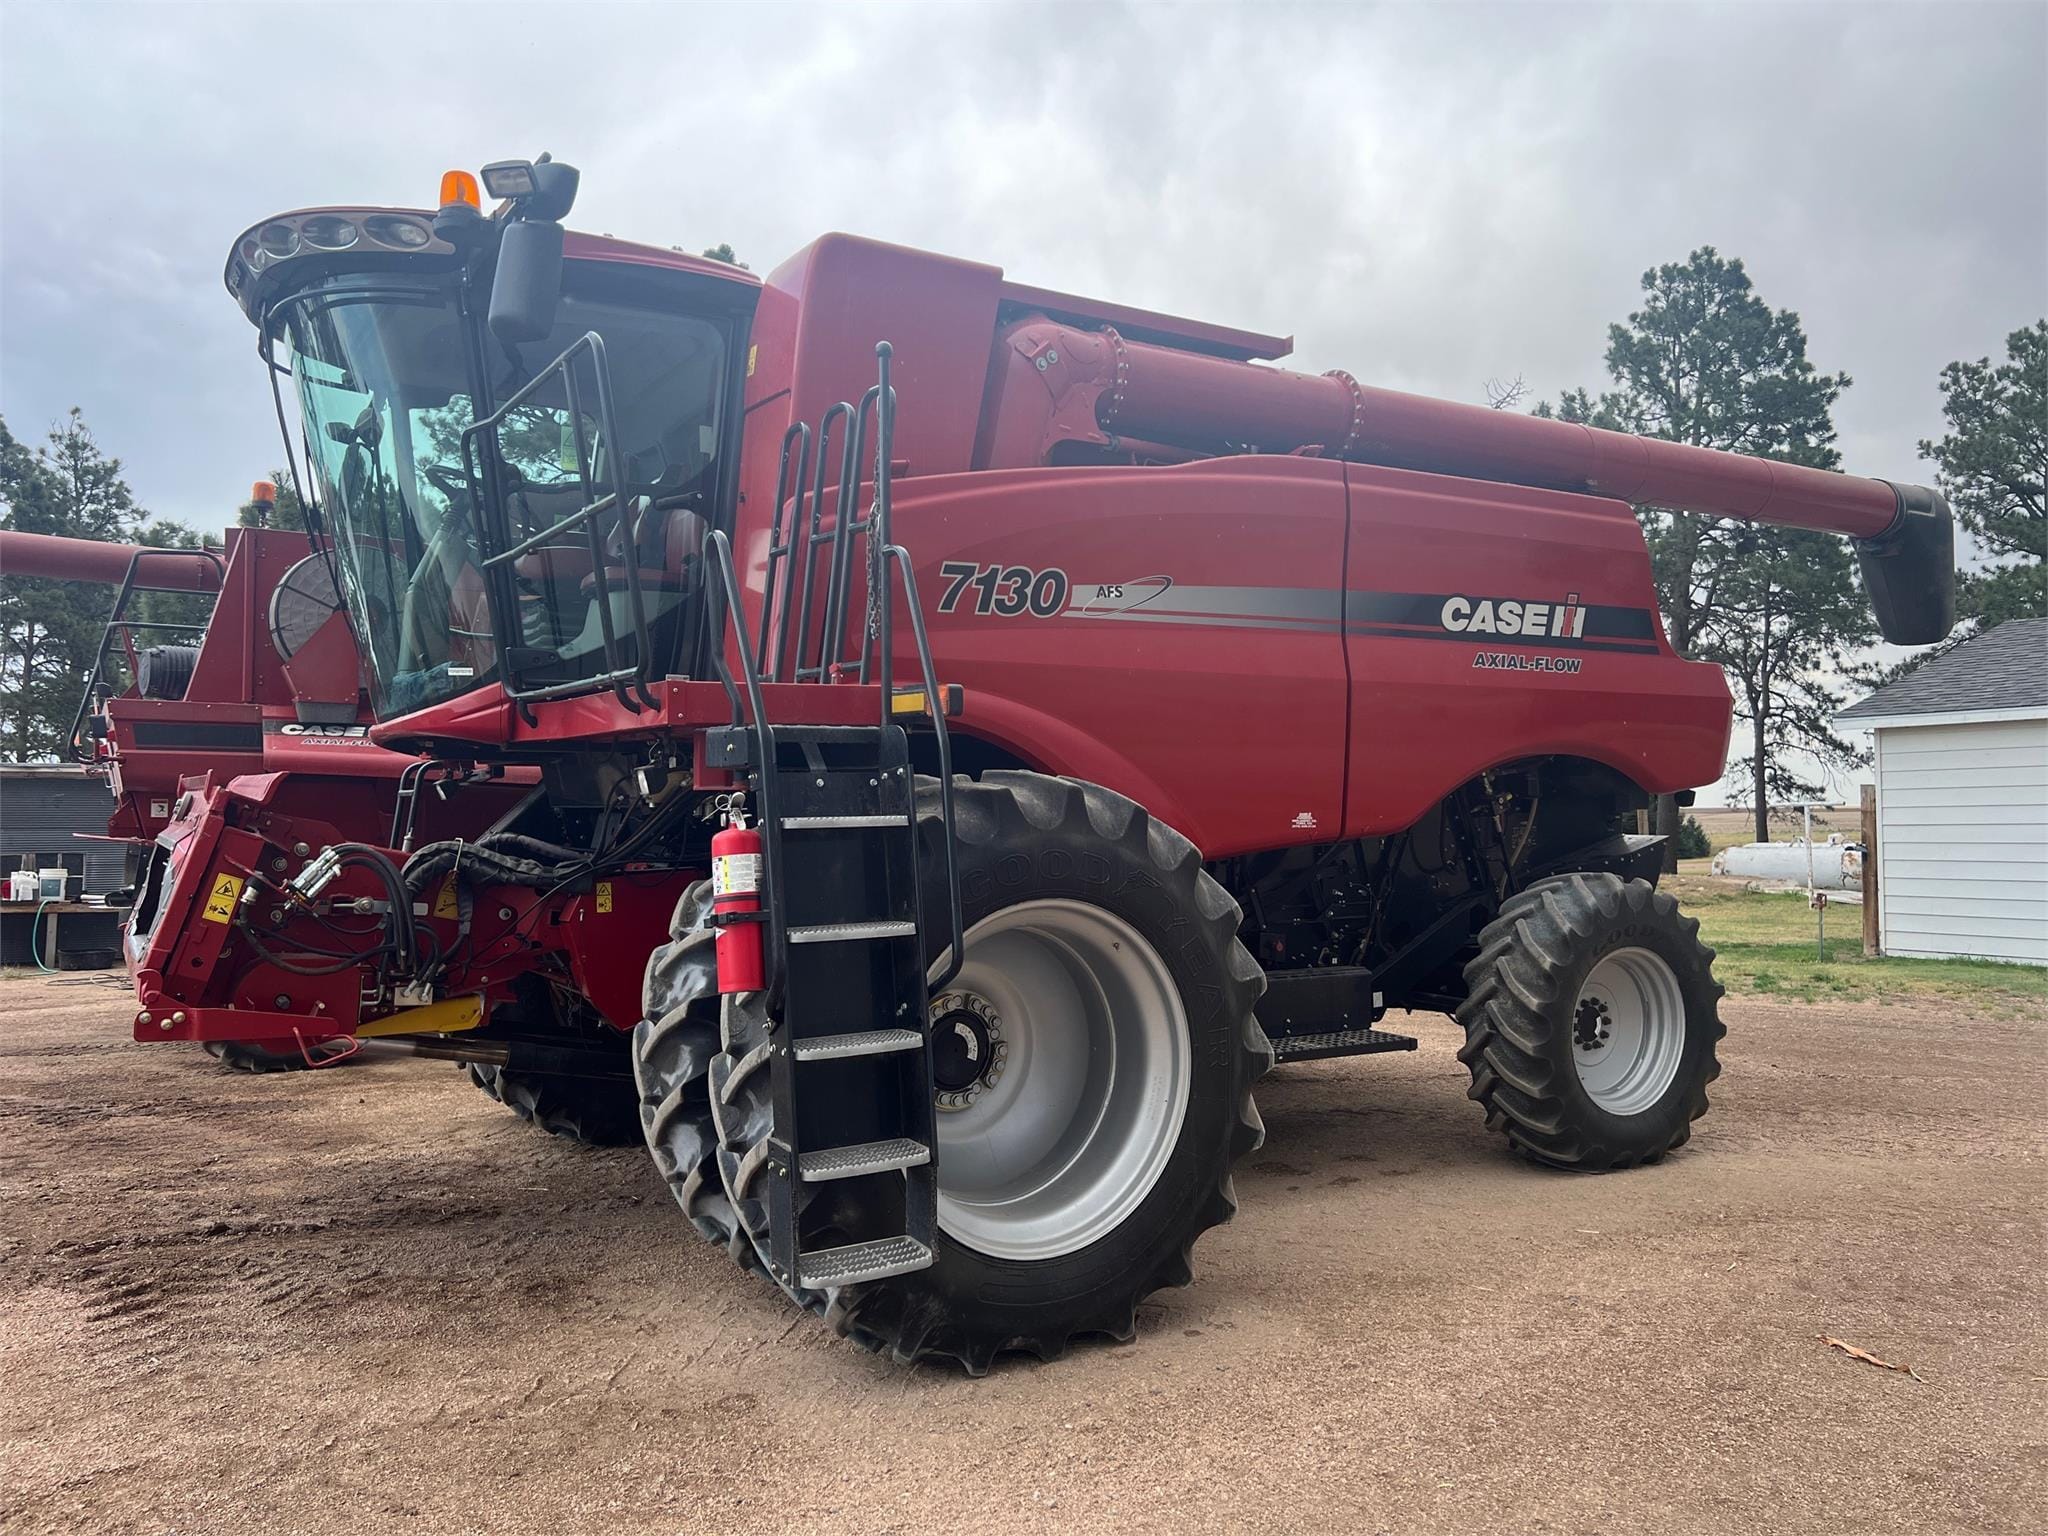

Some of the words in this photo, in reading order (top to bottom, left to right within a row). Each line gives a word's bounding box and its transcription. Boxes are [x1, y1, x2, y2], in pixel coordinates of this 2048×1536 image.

[937, 561, 1068, 618] 7130
[1096, 585, 1123, 599] AFS
[1441, 597, 1549, 636] CASE
[1472, 652, 1582, 673] AXIAL-FLOW
[281, 724, 366, 737] CASE
[301, 737, 377, 747] AXIAL-FLO
